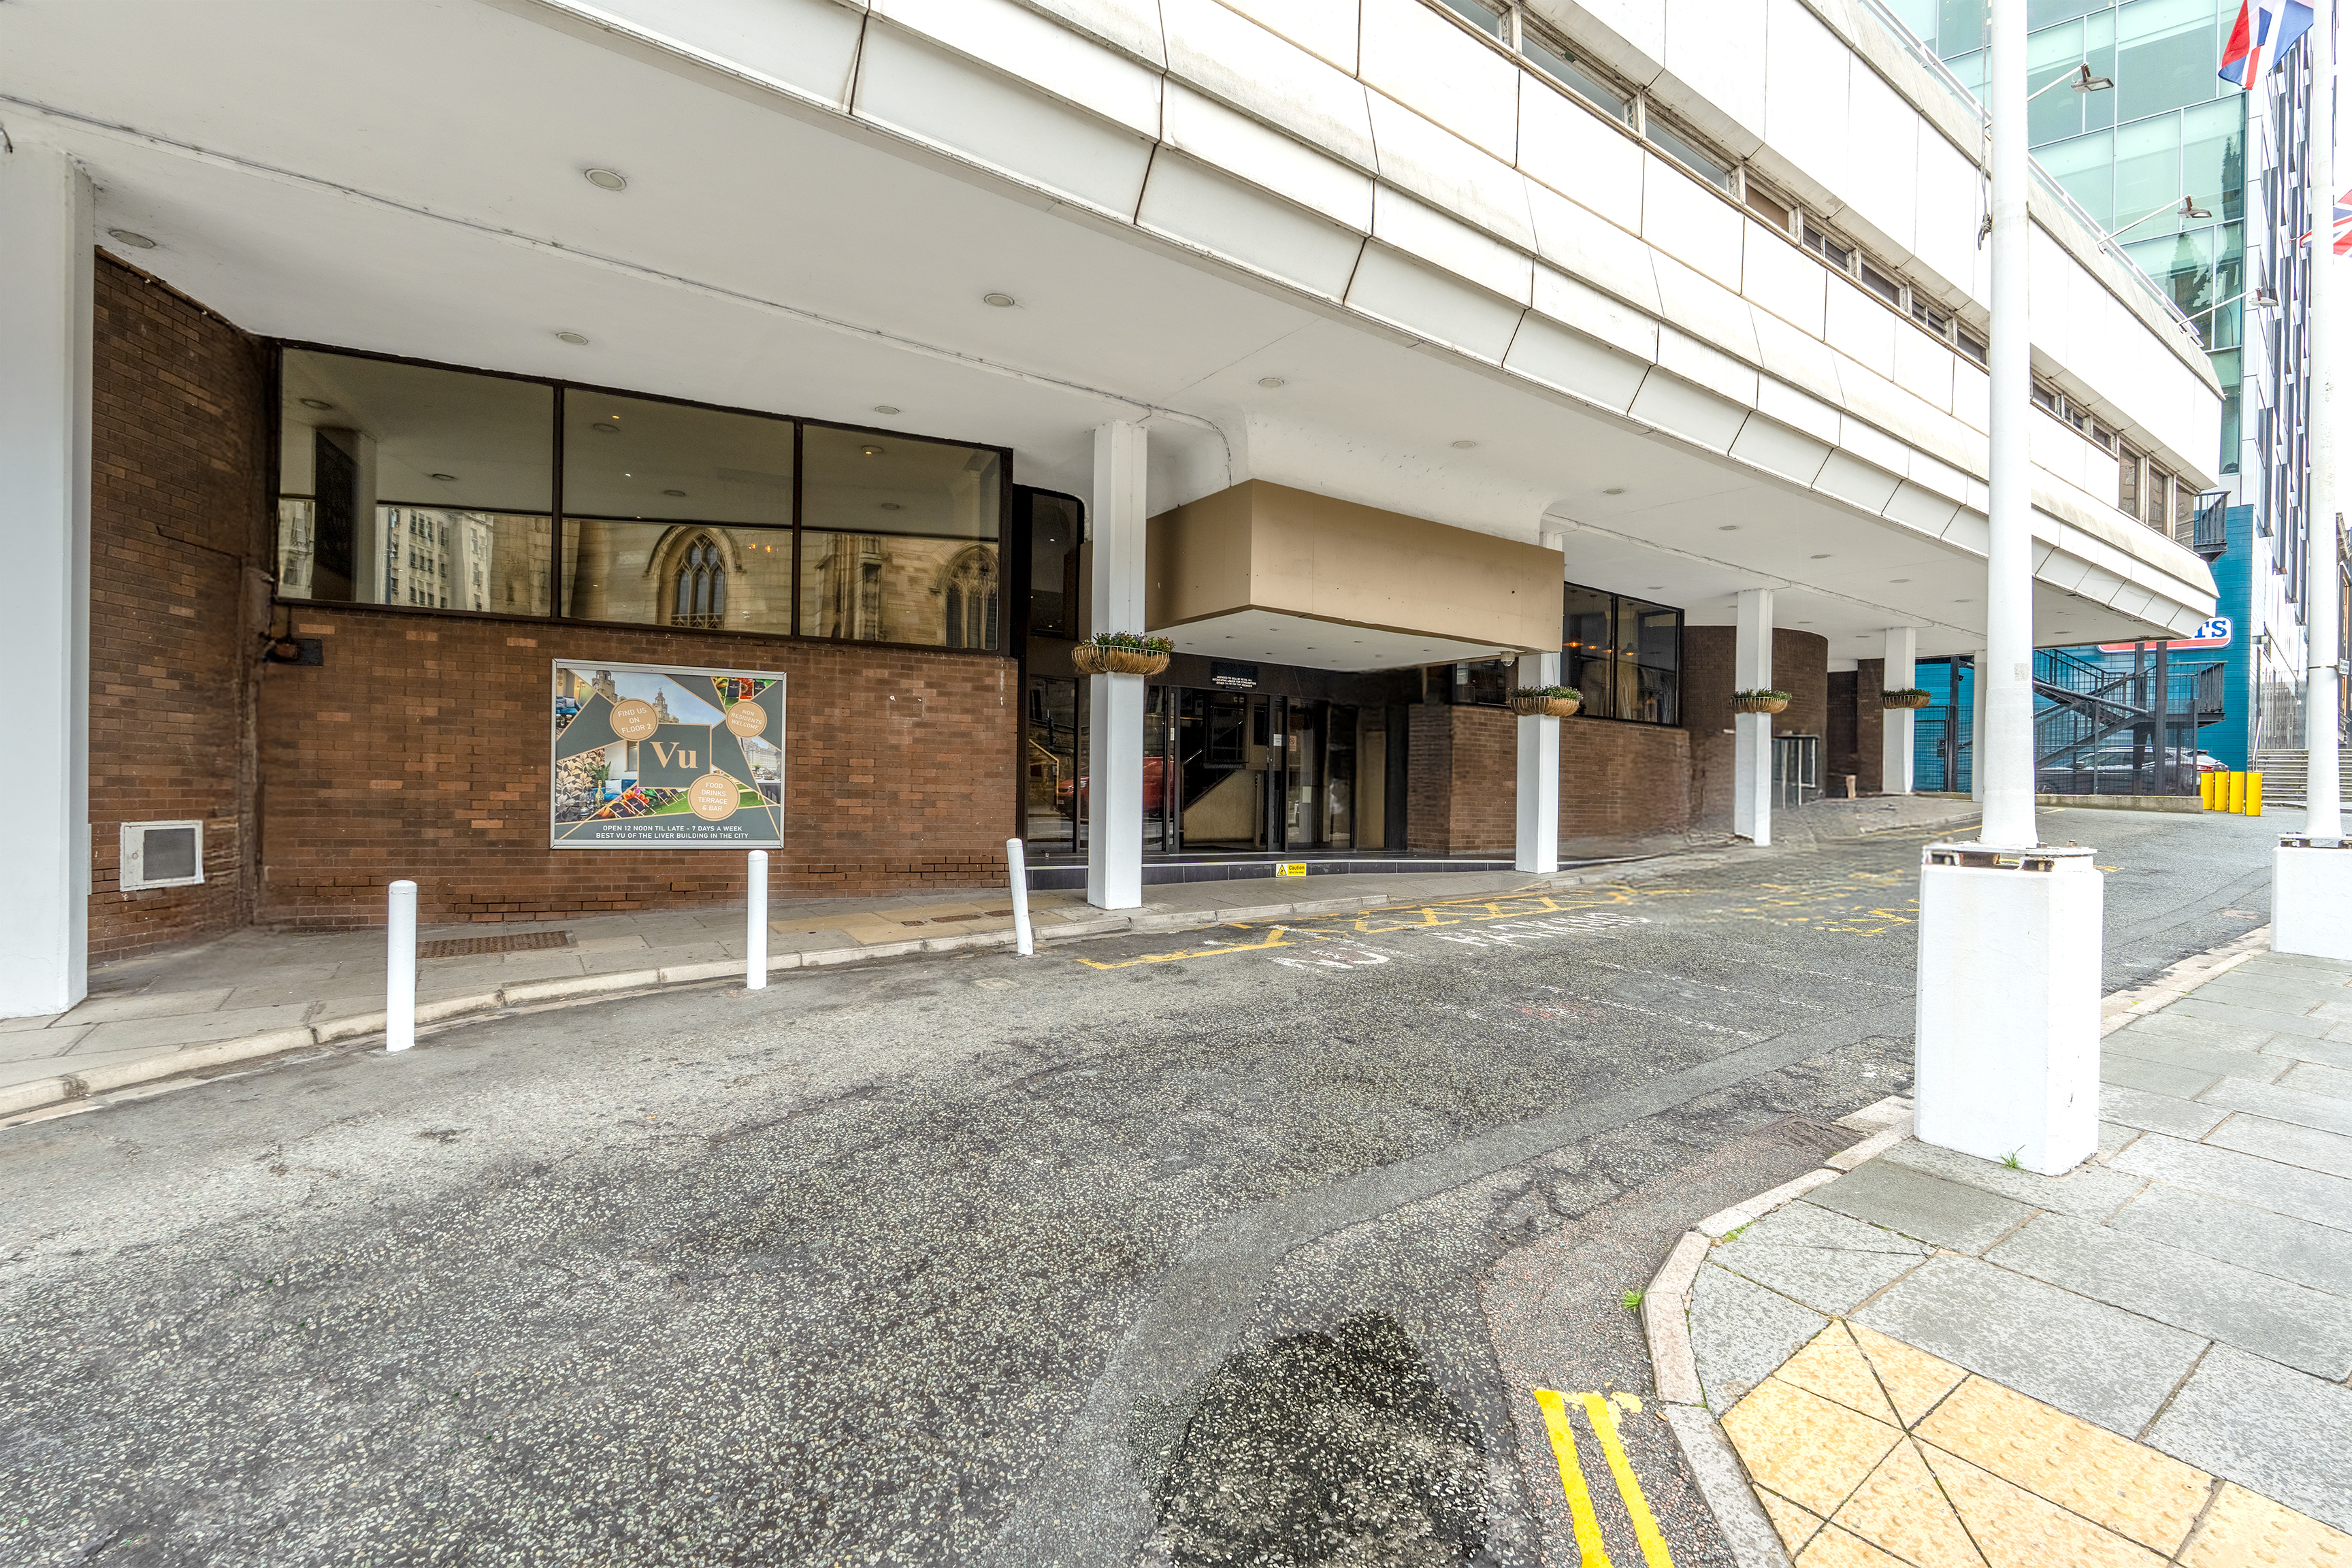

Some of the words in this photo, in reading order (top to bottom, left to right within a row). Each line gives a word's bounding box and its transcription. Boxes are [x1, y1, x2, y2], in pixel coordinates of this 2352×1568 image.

[617, 709, 635, 717] FIND
[731, 713, 763, 725] RESIDENTS
[732, 719, 760, 730] WELCOME
[621, 724, 646, 734] FLOOR
[649, 741, 698, 769] Vu
